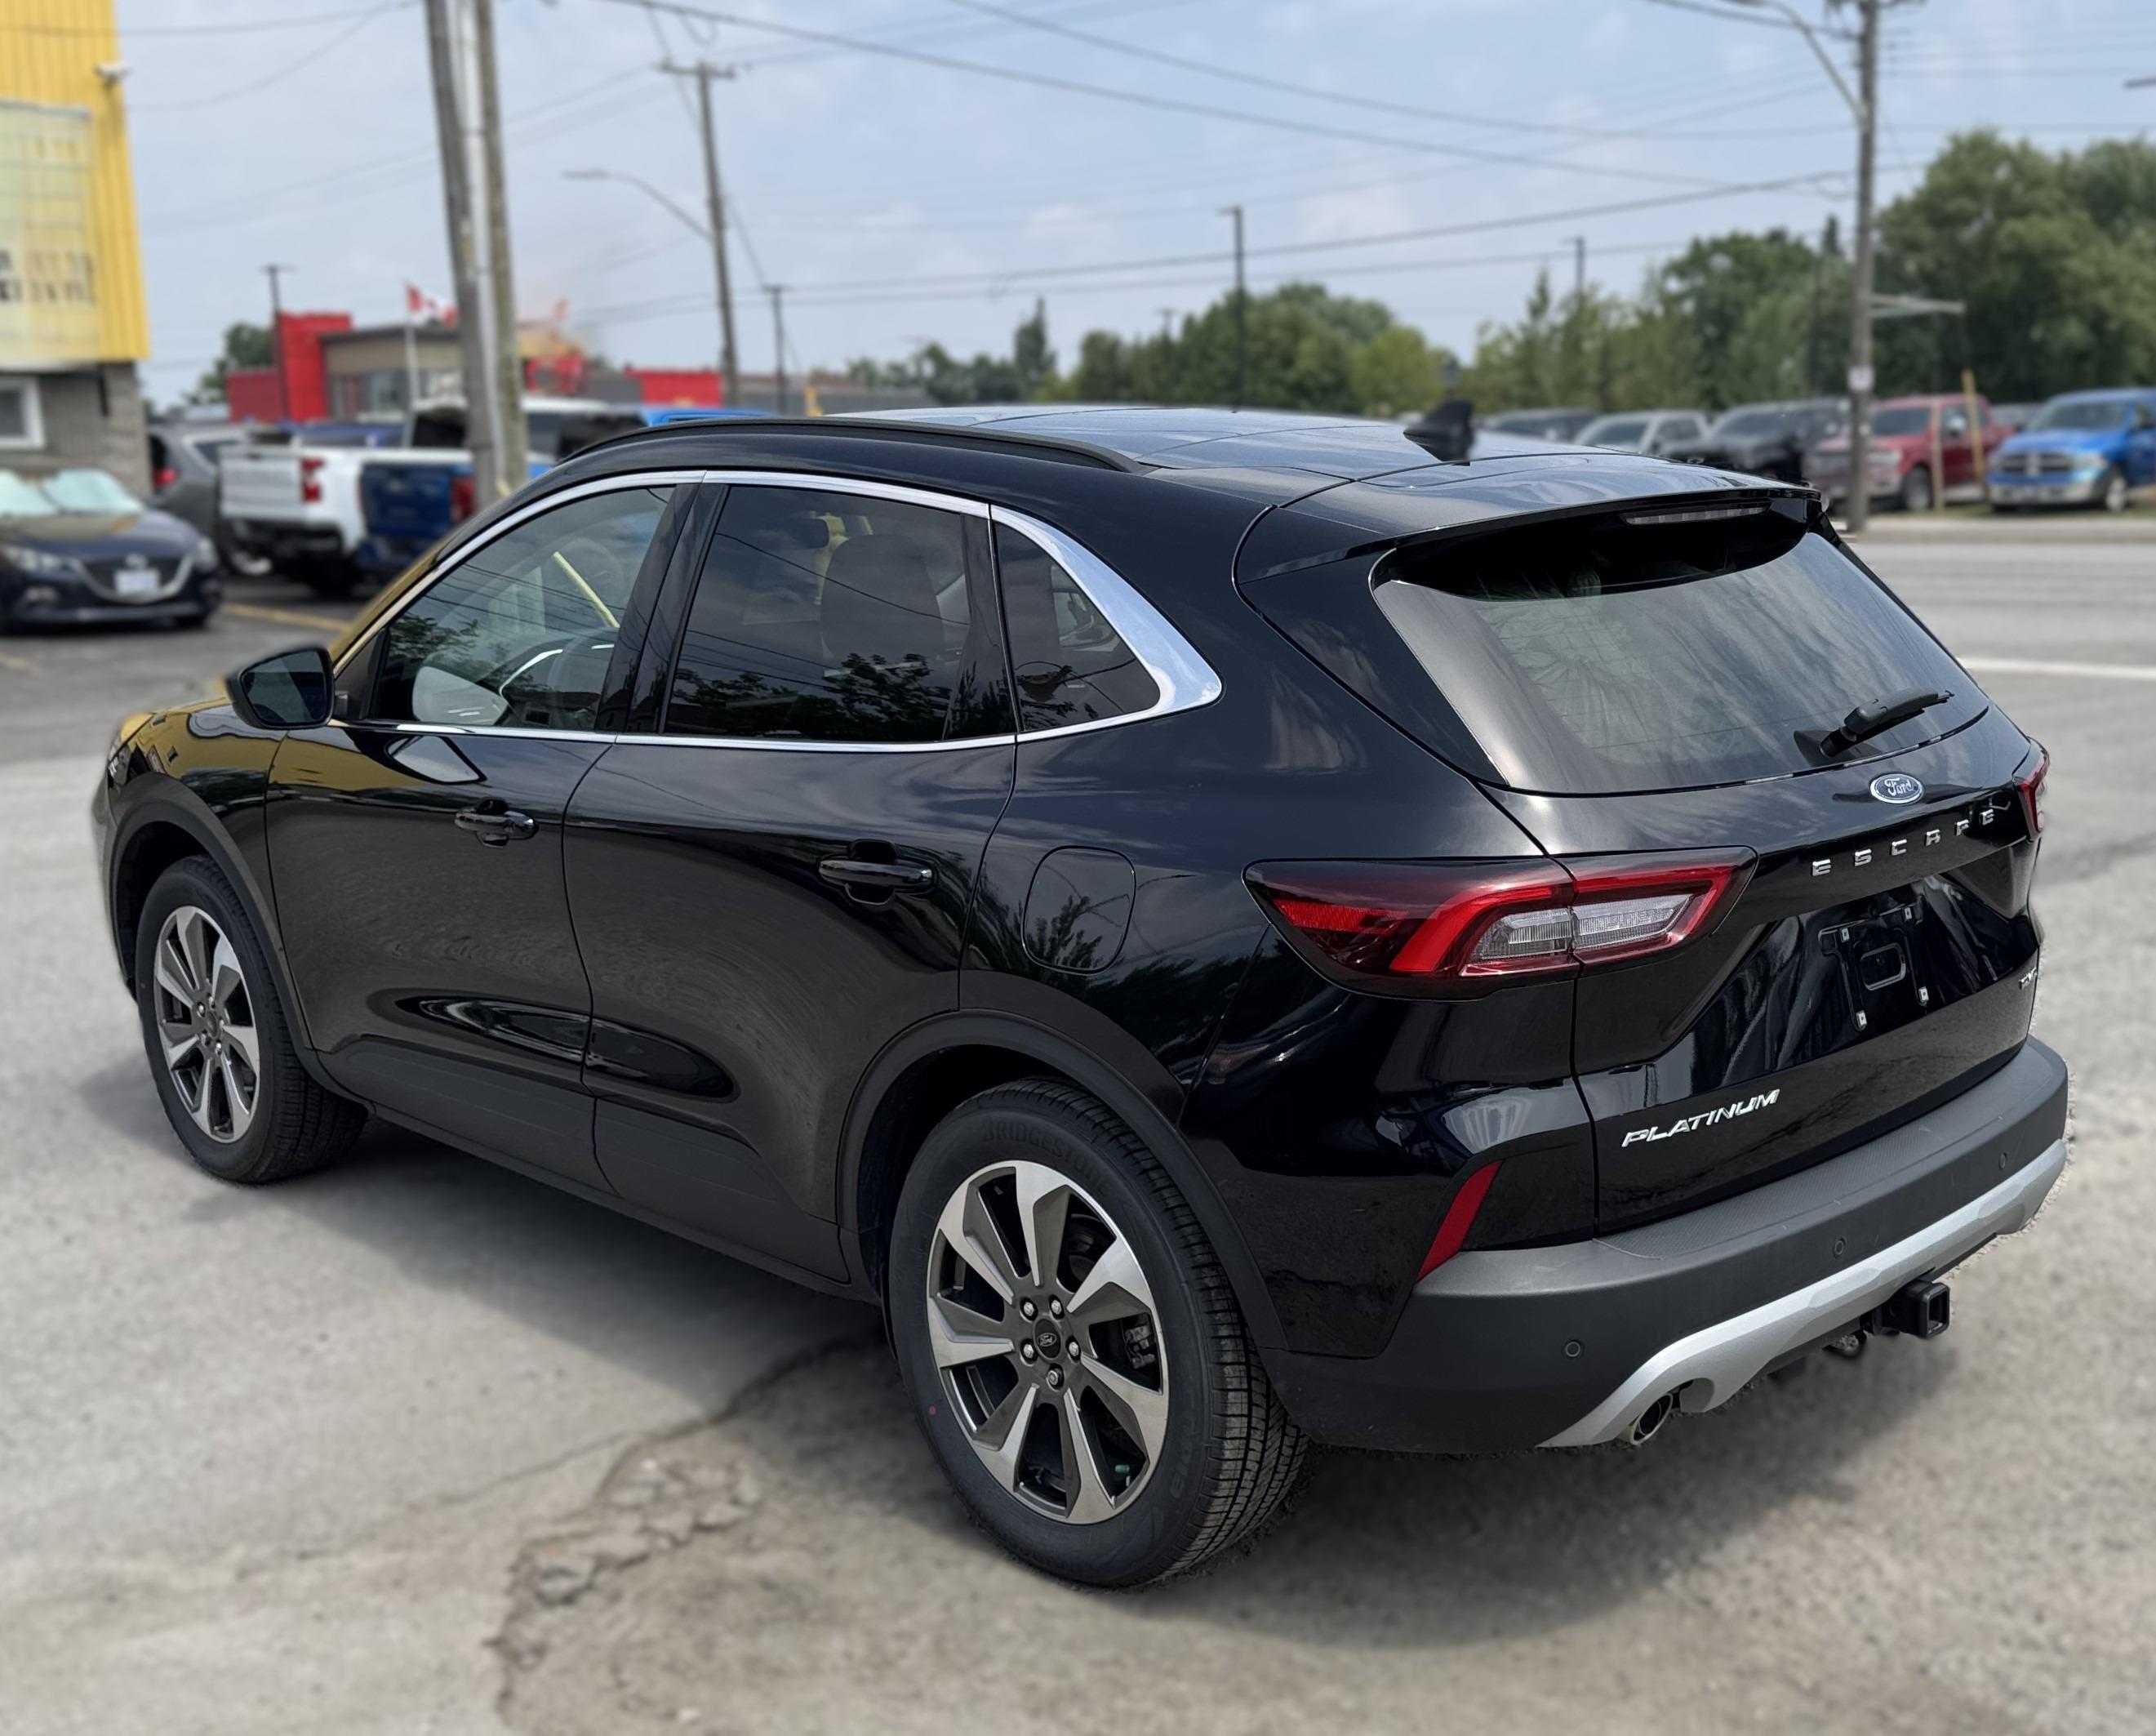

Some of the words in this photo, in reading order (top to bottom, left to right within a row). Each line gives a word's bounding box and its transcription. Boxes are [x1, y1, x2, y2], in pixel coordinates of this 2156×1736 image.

[1883, 777, 1915, 797] Ford
[1811, 808, 1995, 876] ESCAPE
[1621, 1088, 1780, 1147] PLATINUM
[982, 1115, 1112, 1195] BRIDGESTONE
